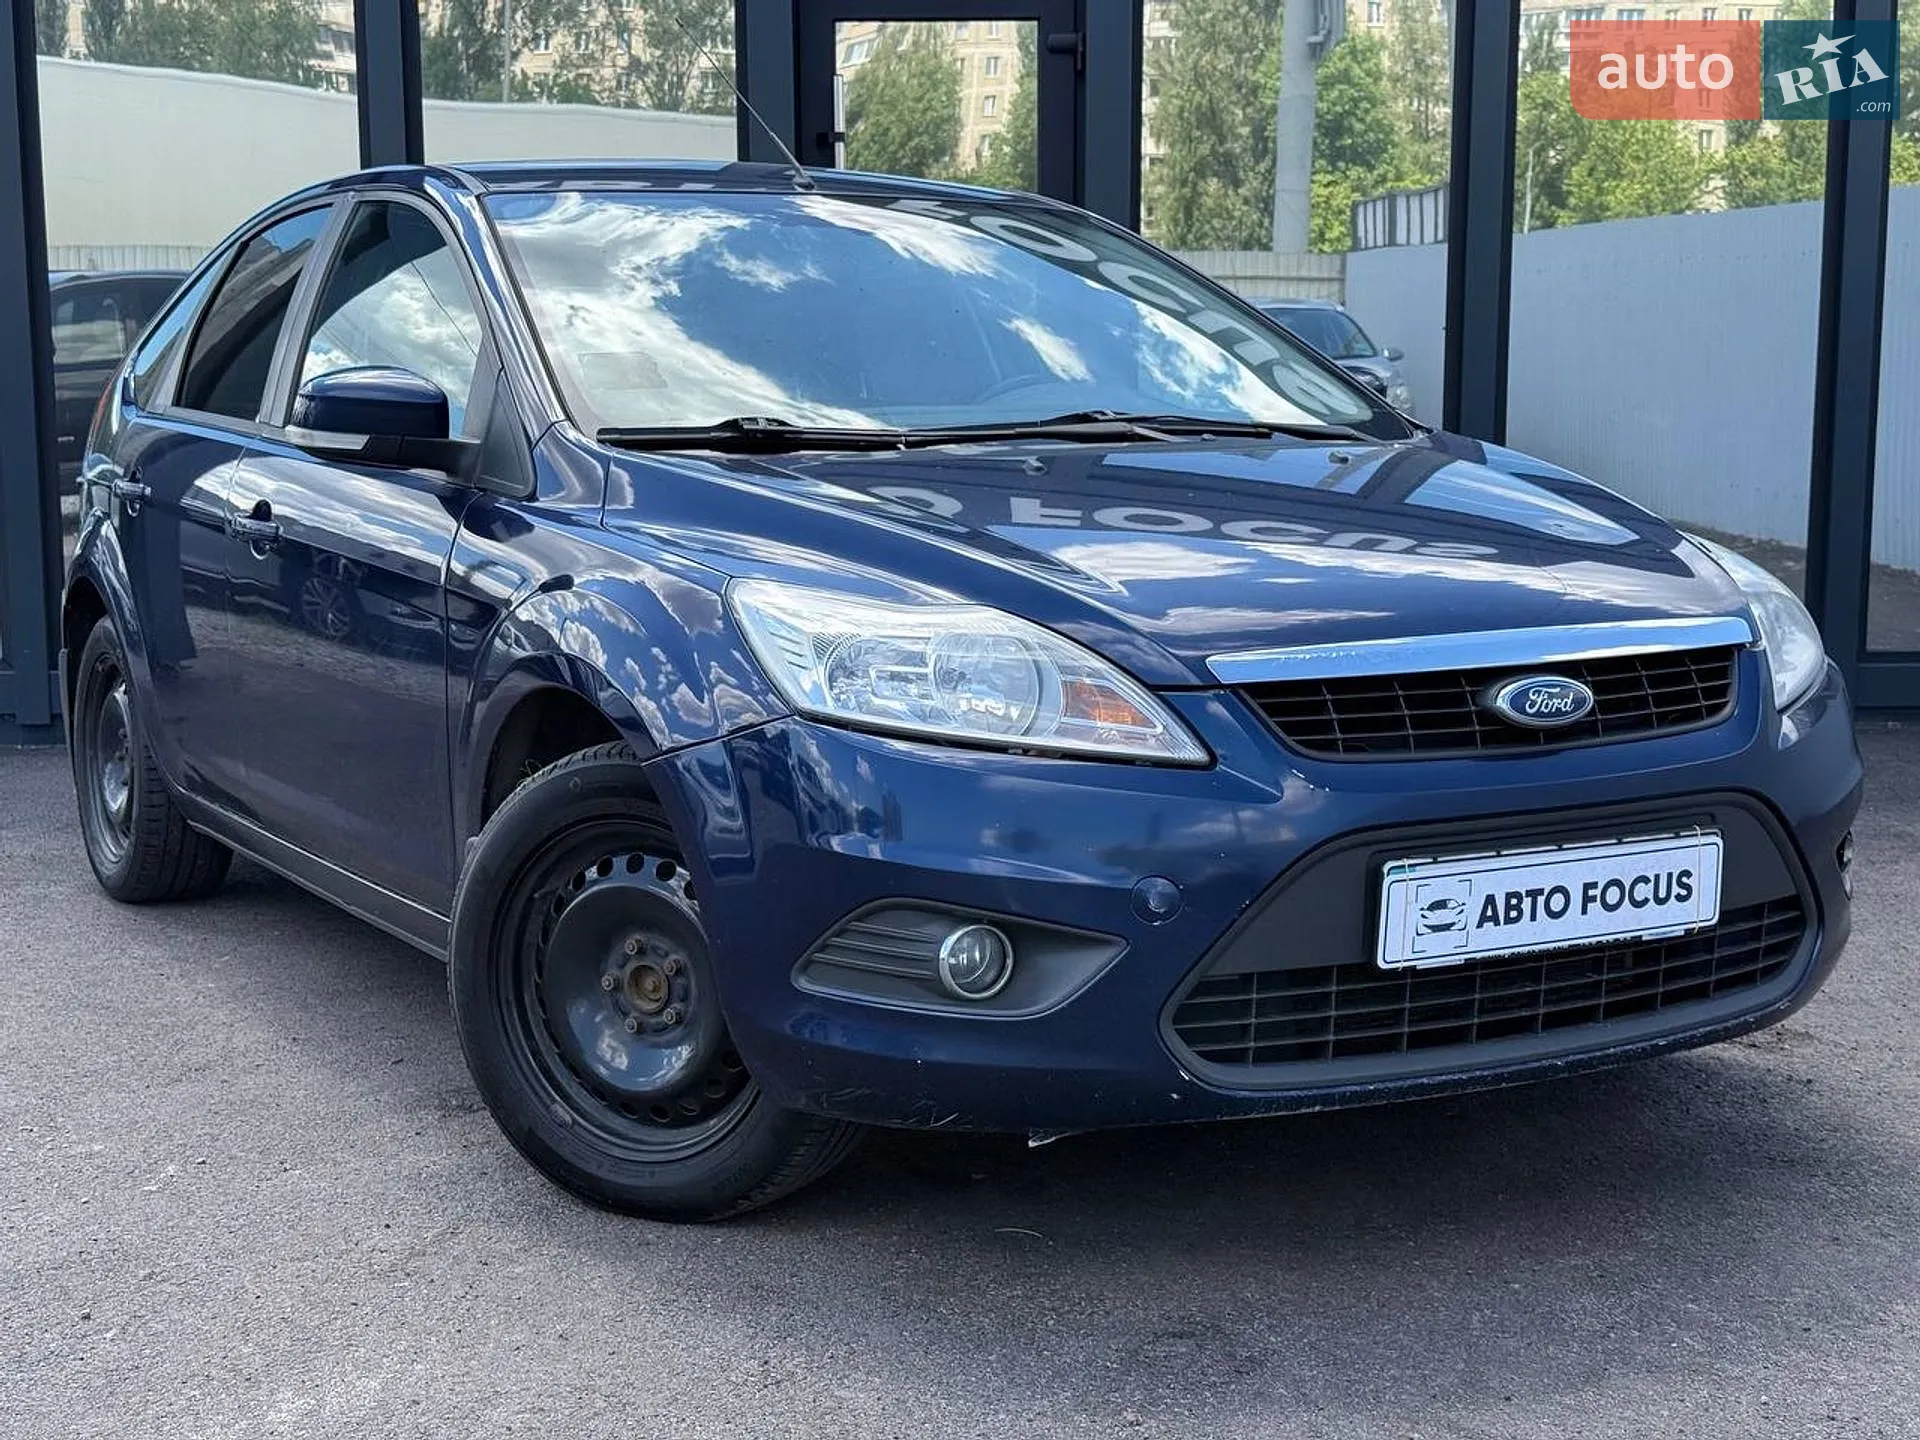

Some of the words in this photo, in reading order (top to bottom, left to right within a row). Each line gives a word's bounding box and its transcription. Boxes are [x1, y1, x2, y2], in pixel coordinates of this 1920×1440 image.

[1525, 687, 1574, 713] Ford
[1475, 886, 1570, 929] АВТО
[1582, 869, 1693, 915] FOCUS
